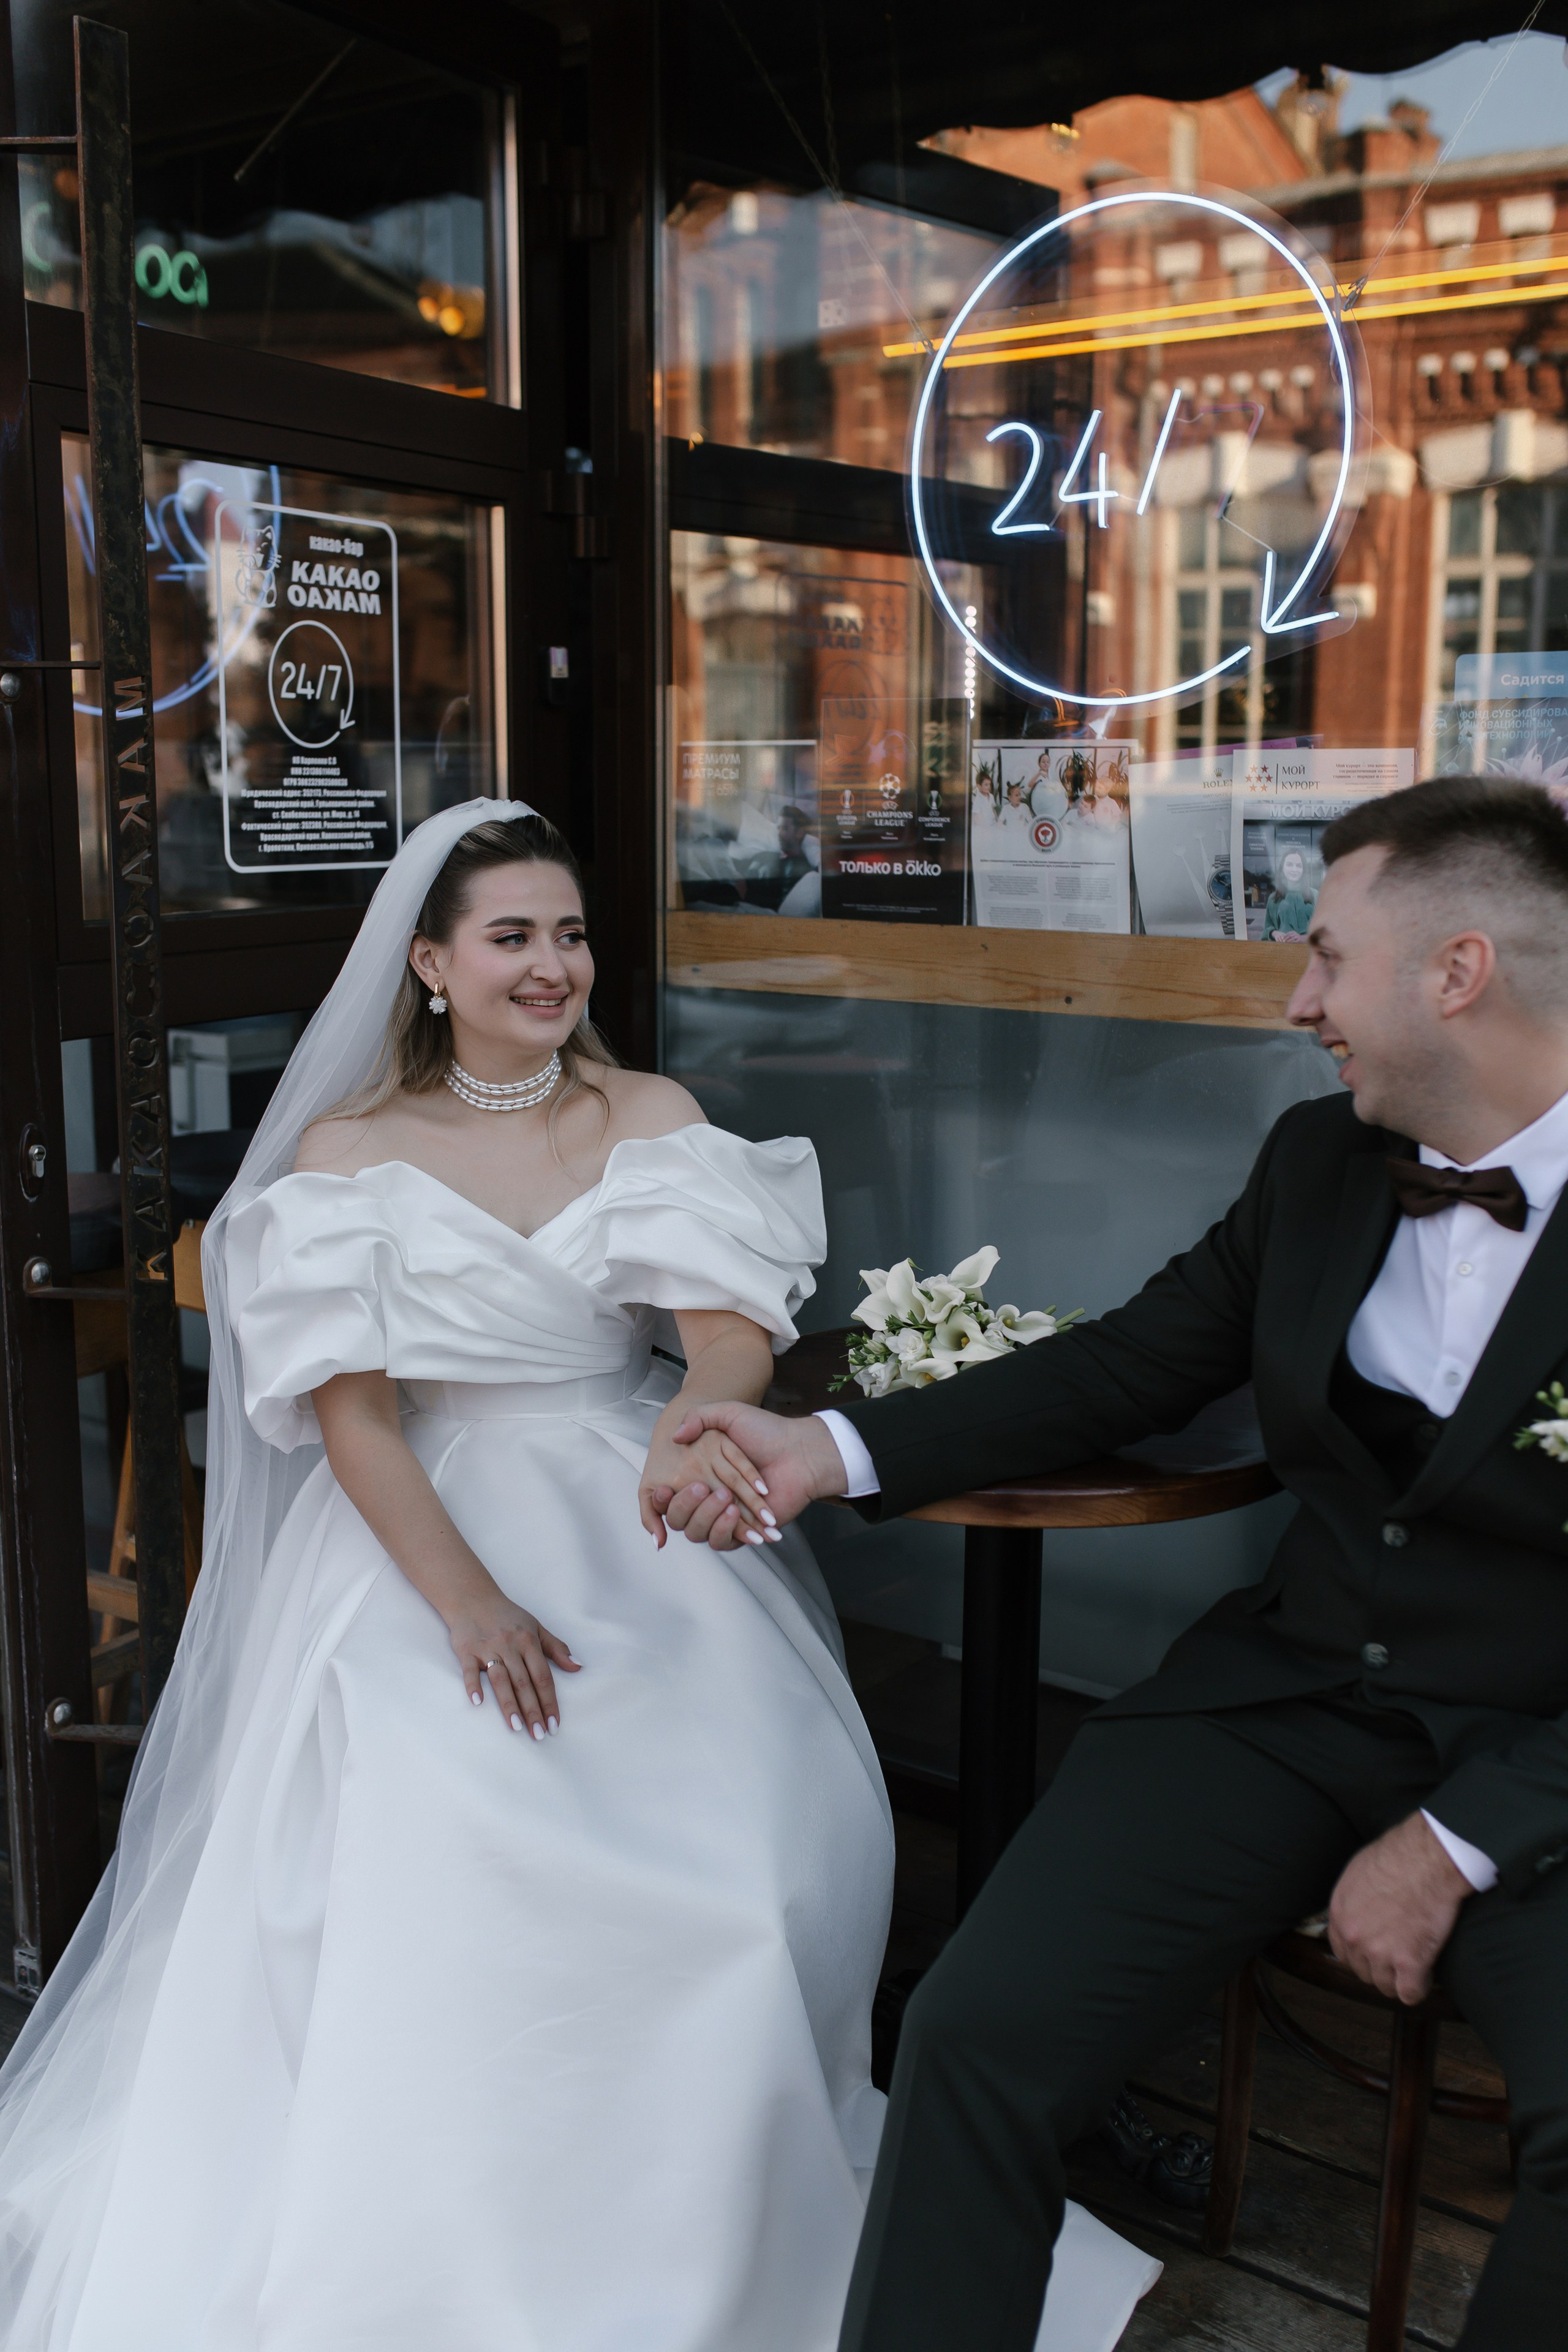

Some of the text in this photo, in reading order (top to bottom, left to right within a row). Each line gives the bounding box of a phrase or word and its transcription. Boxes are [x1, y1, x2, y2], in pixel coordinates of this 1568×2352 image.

[309, 535, 364, 557] какао-бар
[291, 560, 380, 592] КАКАО
[281, 661, 342, 701] 24/7
[1501, 674, 1564, 687] Садится
[1459, 711, 1490, 720] ФОНД
[683, 753, 741, 765] ПРЕМИУМ
[683, 768, 739, 780] МАТРАСЫ
[1282, 764, 1306, 775] МОЙ
[1281, 780, 1321, 790] КУРОРТ
[866, 810, 914, 819] CHAMPIONS
[1270, 801, 1305, 819] МОЙ
